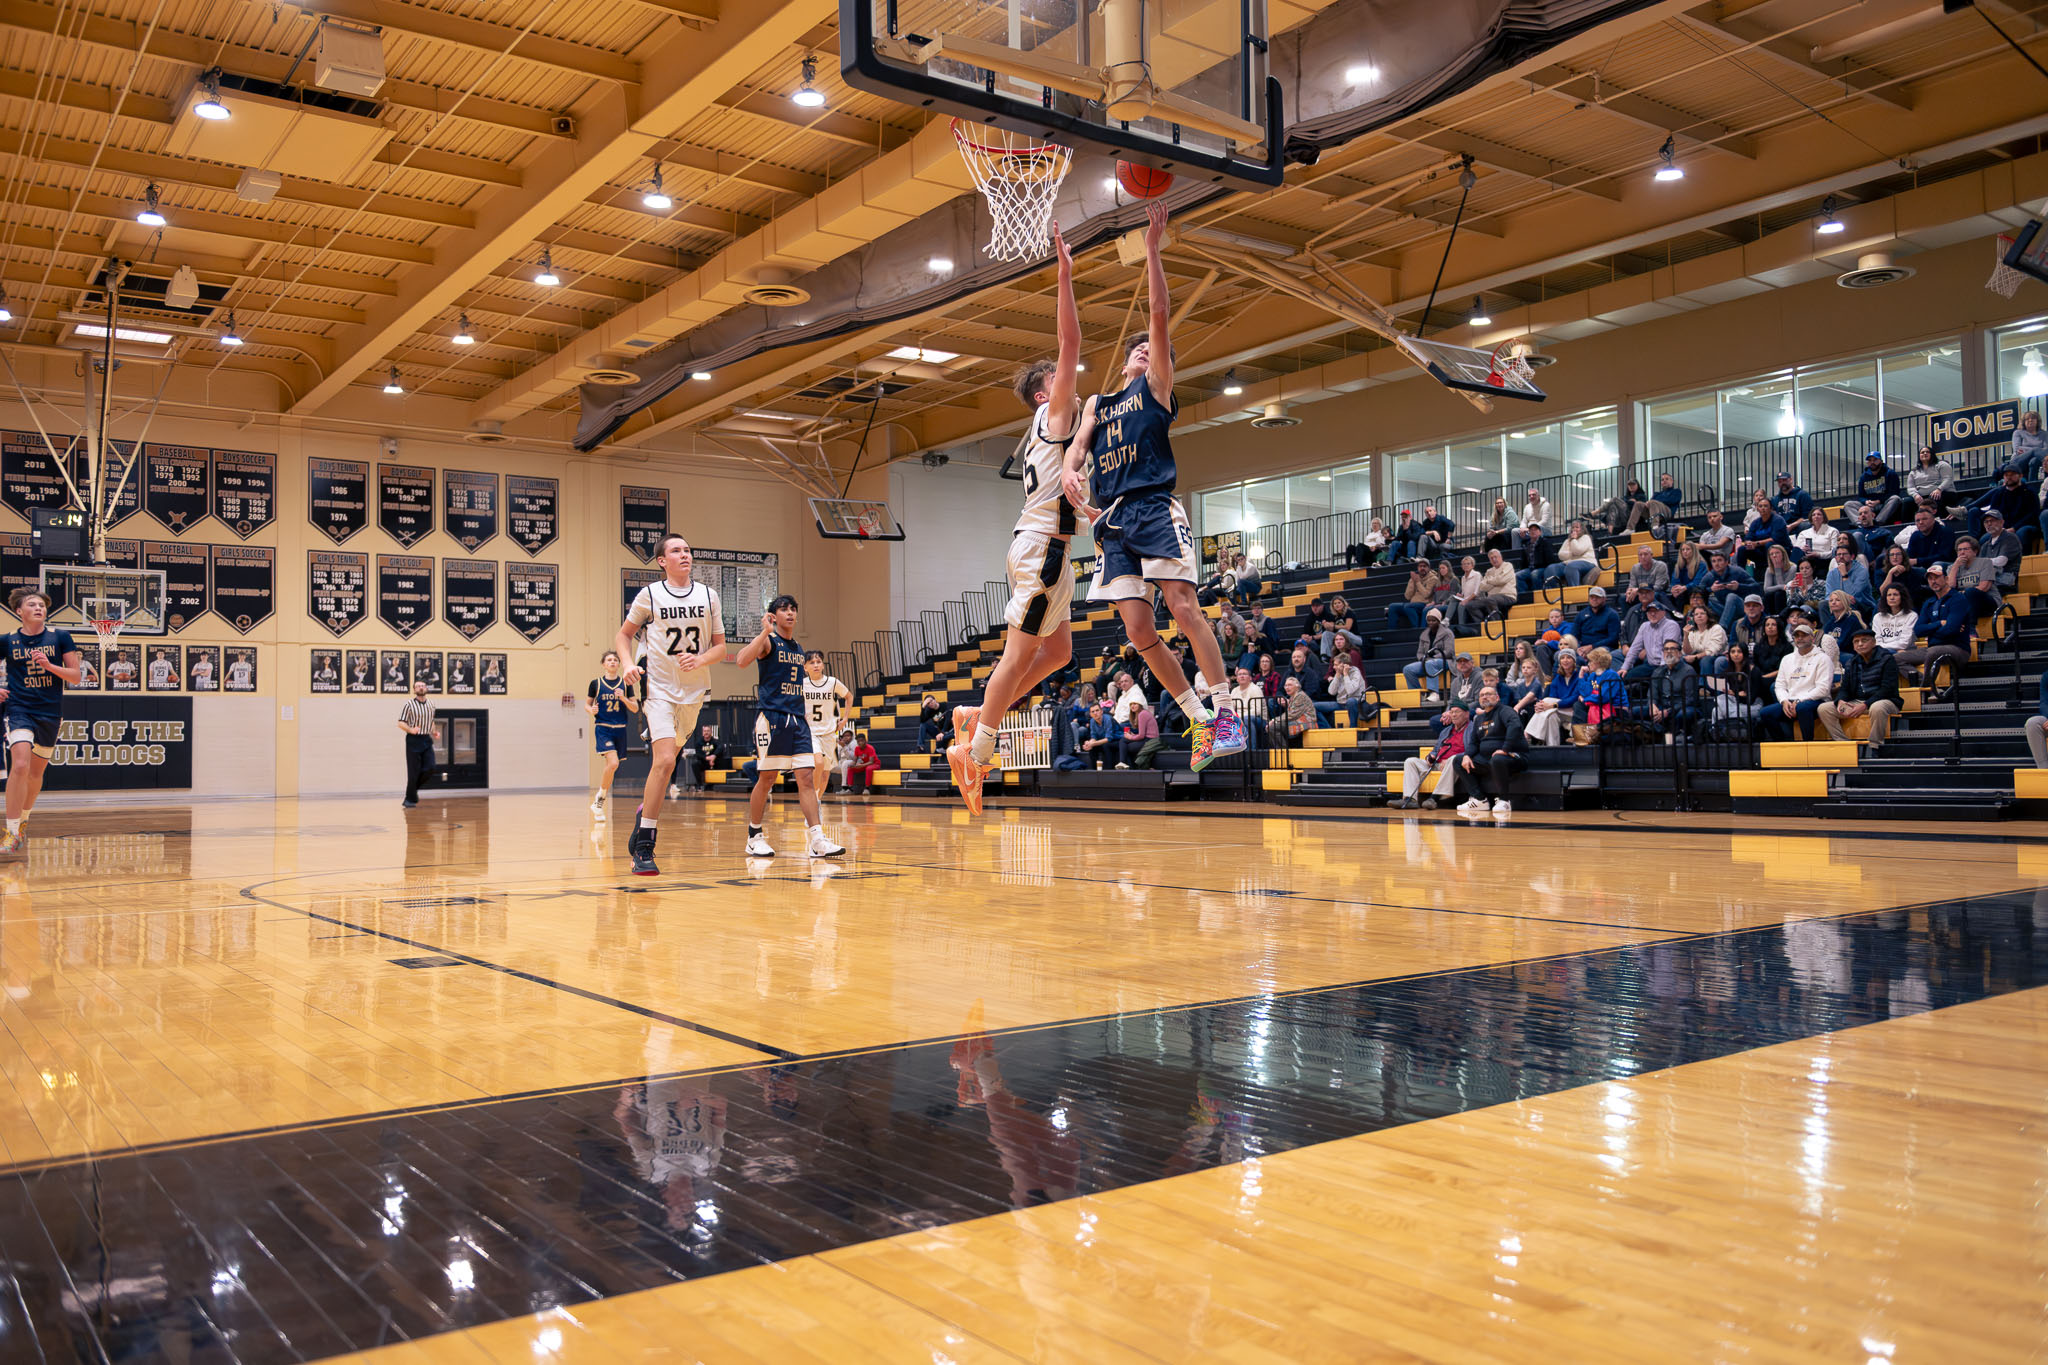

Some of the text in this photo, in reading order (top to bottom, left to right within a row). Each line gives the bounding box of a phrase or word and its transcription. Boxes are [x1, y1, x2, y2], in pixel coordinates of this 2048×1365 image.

[1096, 392, 1144, 425] KHORN
[1933, 409, 2015, 443] HOME
[1106, 418, 1123, 448] 14
[159, 447, 196, 459] BASEBALL
[223, 453, 266, 464] BOYS SOCCER
[24, 460, 46, 469] 2018
[1099, 443, 1137, 475] SOUTH
[155, 465, 200, 475] 1970 1975
[337, 463, 360, 473] TENNIS
[155, 472, 201, 481] 1979 1992
[224, 477, 265, 487] 1990 1994
[10, 485, 60, 495] 1980 1984
[398, 494, 415, 502] 1992
[514, 497, 530, 505] 1992
[222, 511, 266, 521] 1997 2002
[330, 512, 348, 521] 1974
[398, 516, 416, 524] 1994
[160, 544, 193, 555] SOFTBALL
[221, 548, 266, 559] GIRLS SOCCER
[693, 550, 764, 562] BURKE HIGH SCHOOL
[397, 606, 415, 614] 1993
[660, 605, 705, 620] BURKE
[665, 626, 700, 655] 23
[790, 666, 798, 682] 3
[24, 675, 53, 688] SOUTH
[781, 682, 804, 696] SOUTH
[805, 692, 832, 700] BURKE
[606, 700, 620, 712] 24
[812, 704, 823, 722] 5
[58, 720, 185, 741] ME OF THE
[758, 733, 769, 747] ES
[48, 744, 166, 766] ULLDOGS
